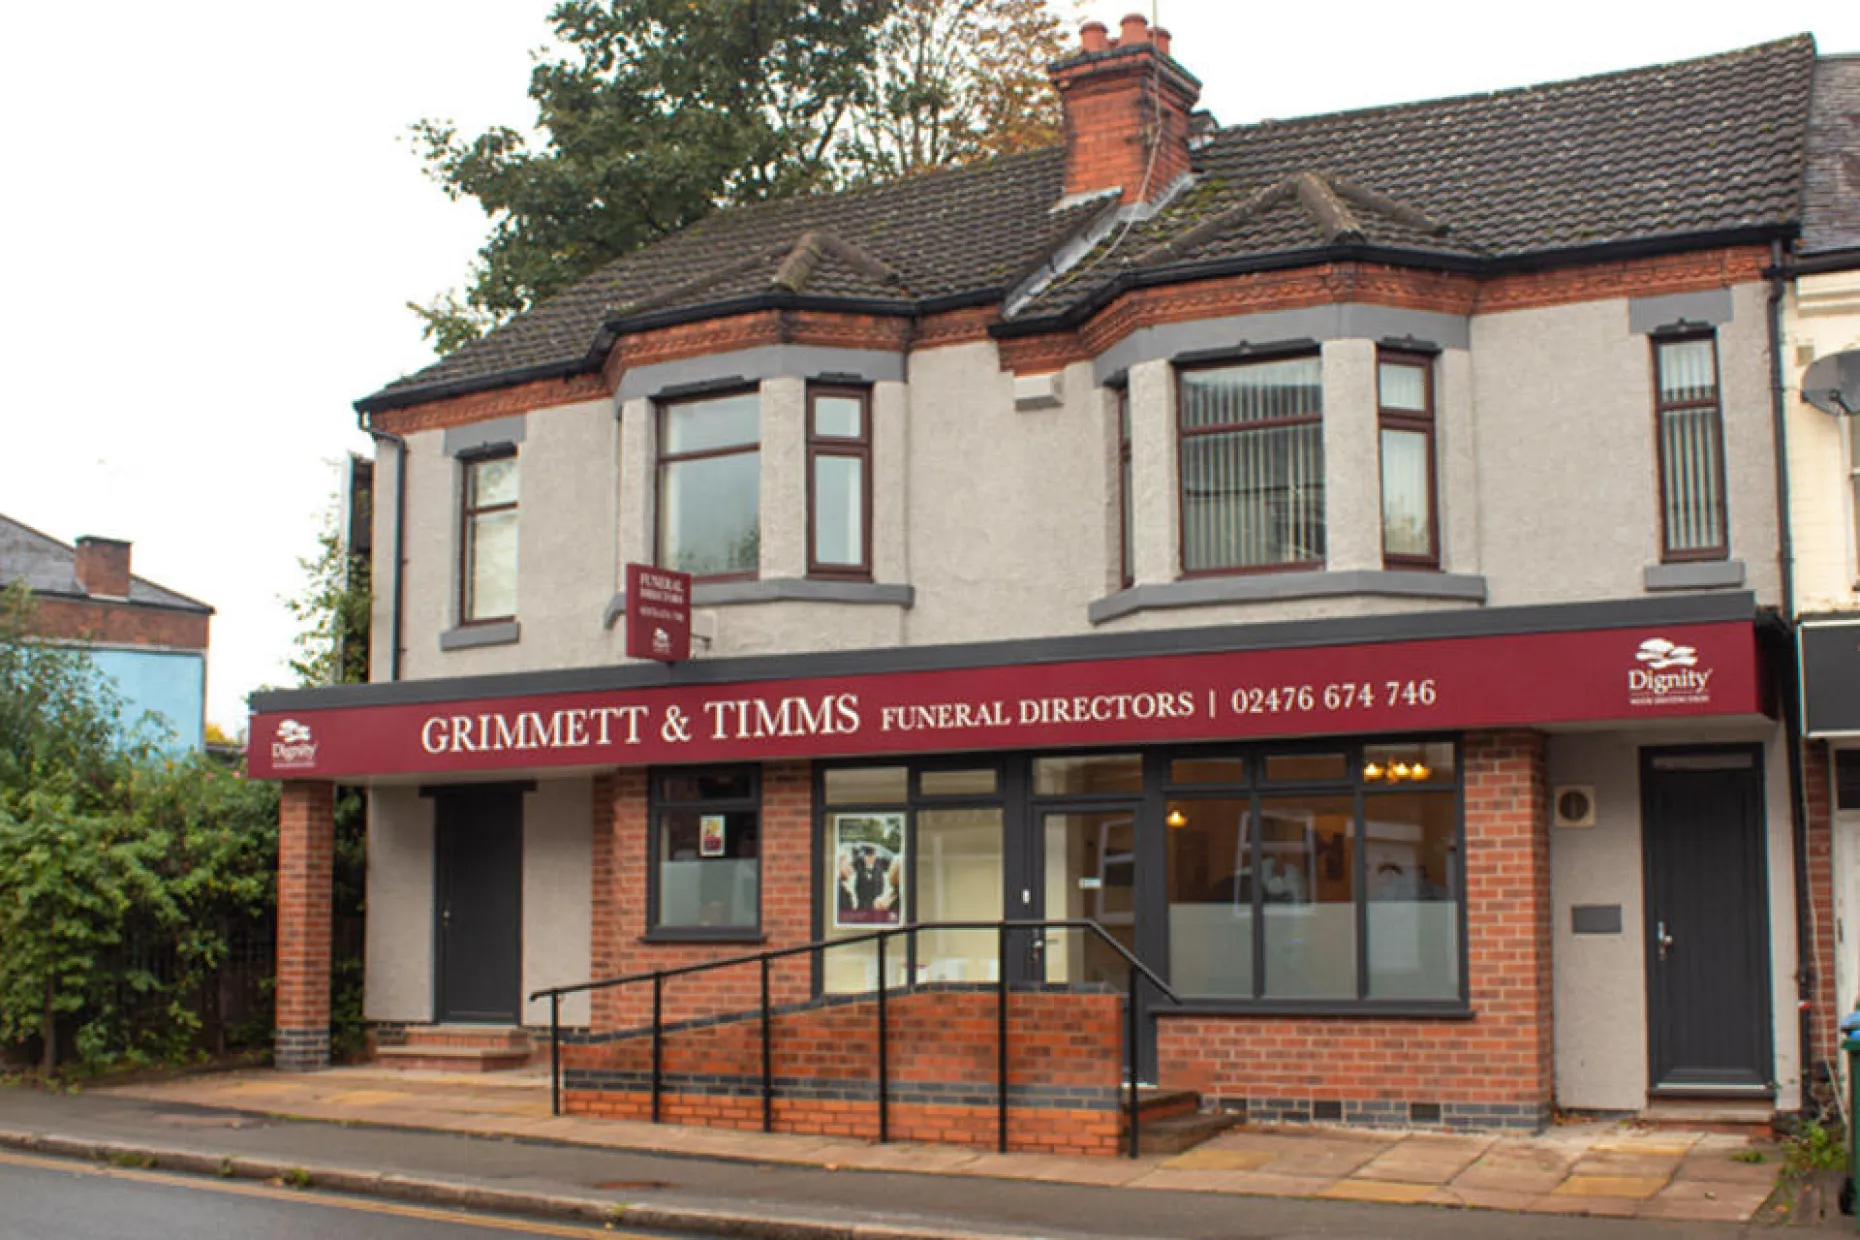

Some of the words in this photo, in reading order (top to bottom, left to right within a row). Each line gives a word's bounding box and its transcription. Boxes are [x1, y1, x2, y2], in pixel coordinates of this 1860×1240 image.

[1628, 668, 1711, 694] Dignity
[421, 705, 649, 754] GRIMMETT
[661, 704, 692, 742] &
[704, 693, 860, 739] TIMMS
[880, 698, 1012, 731] FUNERAL
[1018, 691, 1195, 724] DIRECTORS
[1230, 685, 1314, 715] 02476
[1323, 681, 1375, 710] 674
[1386, 678, 1437, 706] 746
